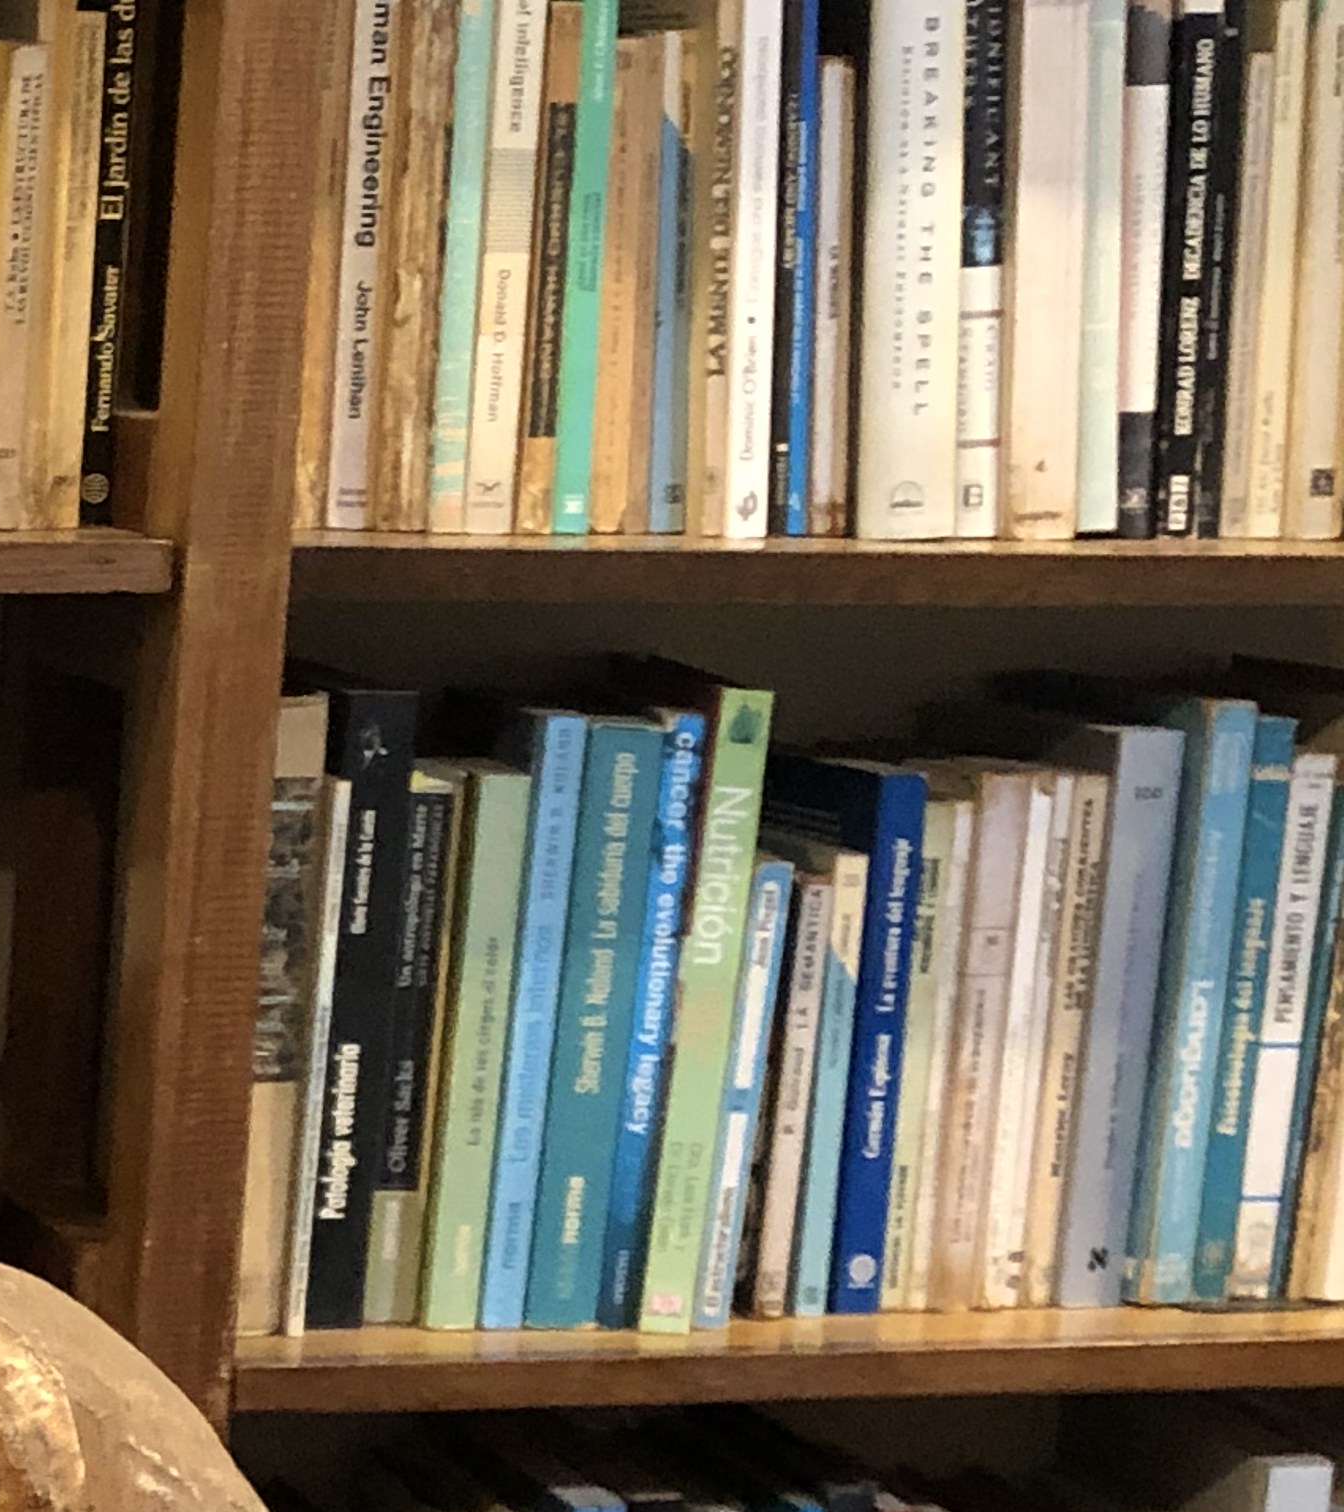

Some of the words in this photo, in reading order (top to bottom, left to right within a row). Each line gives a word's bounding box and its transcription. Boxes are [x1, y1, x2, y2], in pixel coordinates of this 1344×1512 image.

[109, 27, 135, 65] las
[1191, 38, 1216, 116] HUMANO
[107, 70, 132, 106] de
[920, 16, 942, 198] BREAKING
[353, 75, 392, 249] Engineering
[1189, 147, 1209, 170] DE
[1191, 119, 1211, 143] LO
[98, 193, 125, 221] El
[917, 221, 937, 286] THE
[91, 264, 120, 342] Savater
[354, 280, 373, 333] John
[492, 268, 512, 325] Donald
[90, 342, 114, 433] Fernando
[348, 338, 370, 420] Lenihan
[913, 309, 934, 417] SPELL
[667, 730, 697, 832] cancer
[662, 842, 686, 885] the
[691, 784, 754, 965] Nutrición
[637, 892, 677, 1047] evolutionary
[1273, 911, 1306, 1025] PENSAMIENTO
[626, 1053, 661, 1135] legacy
